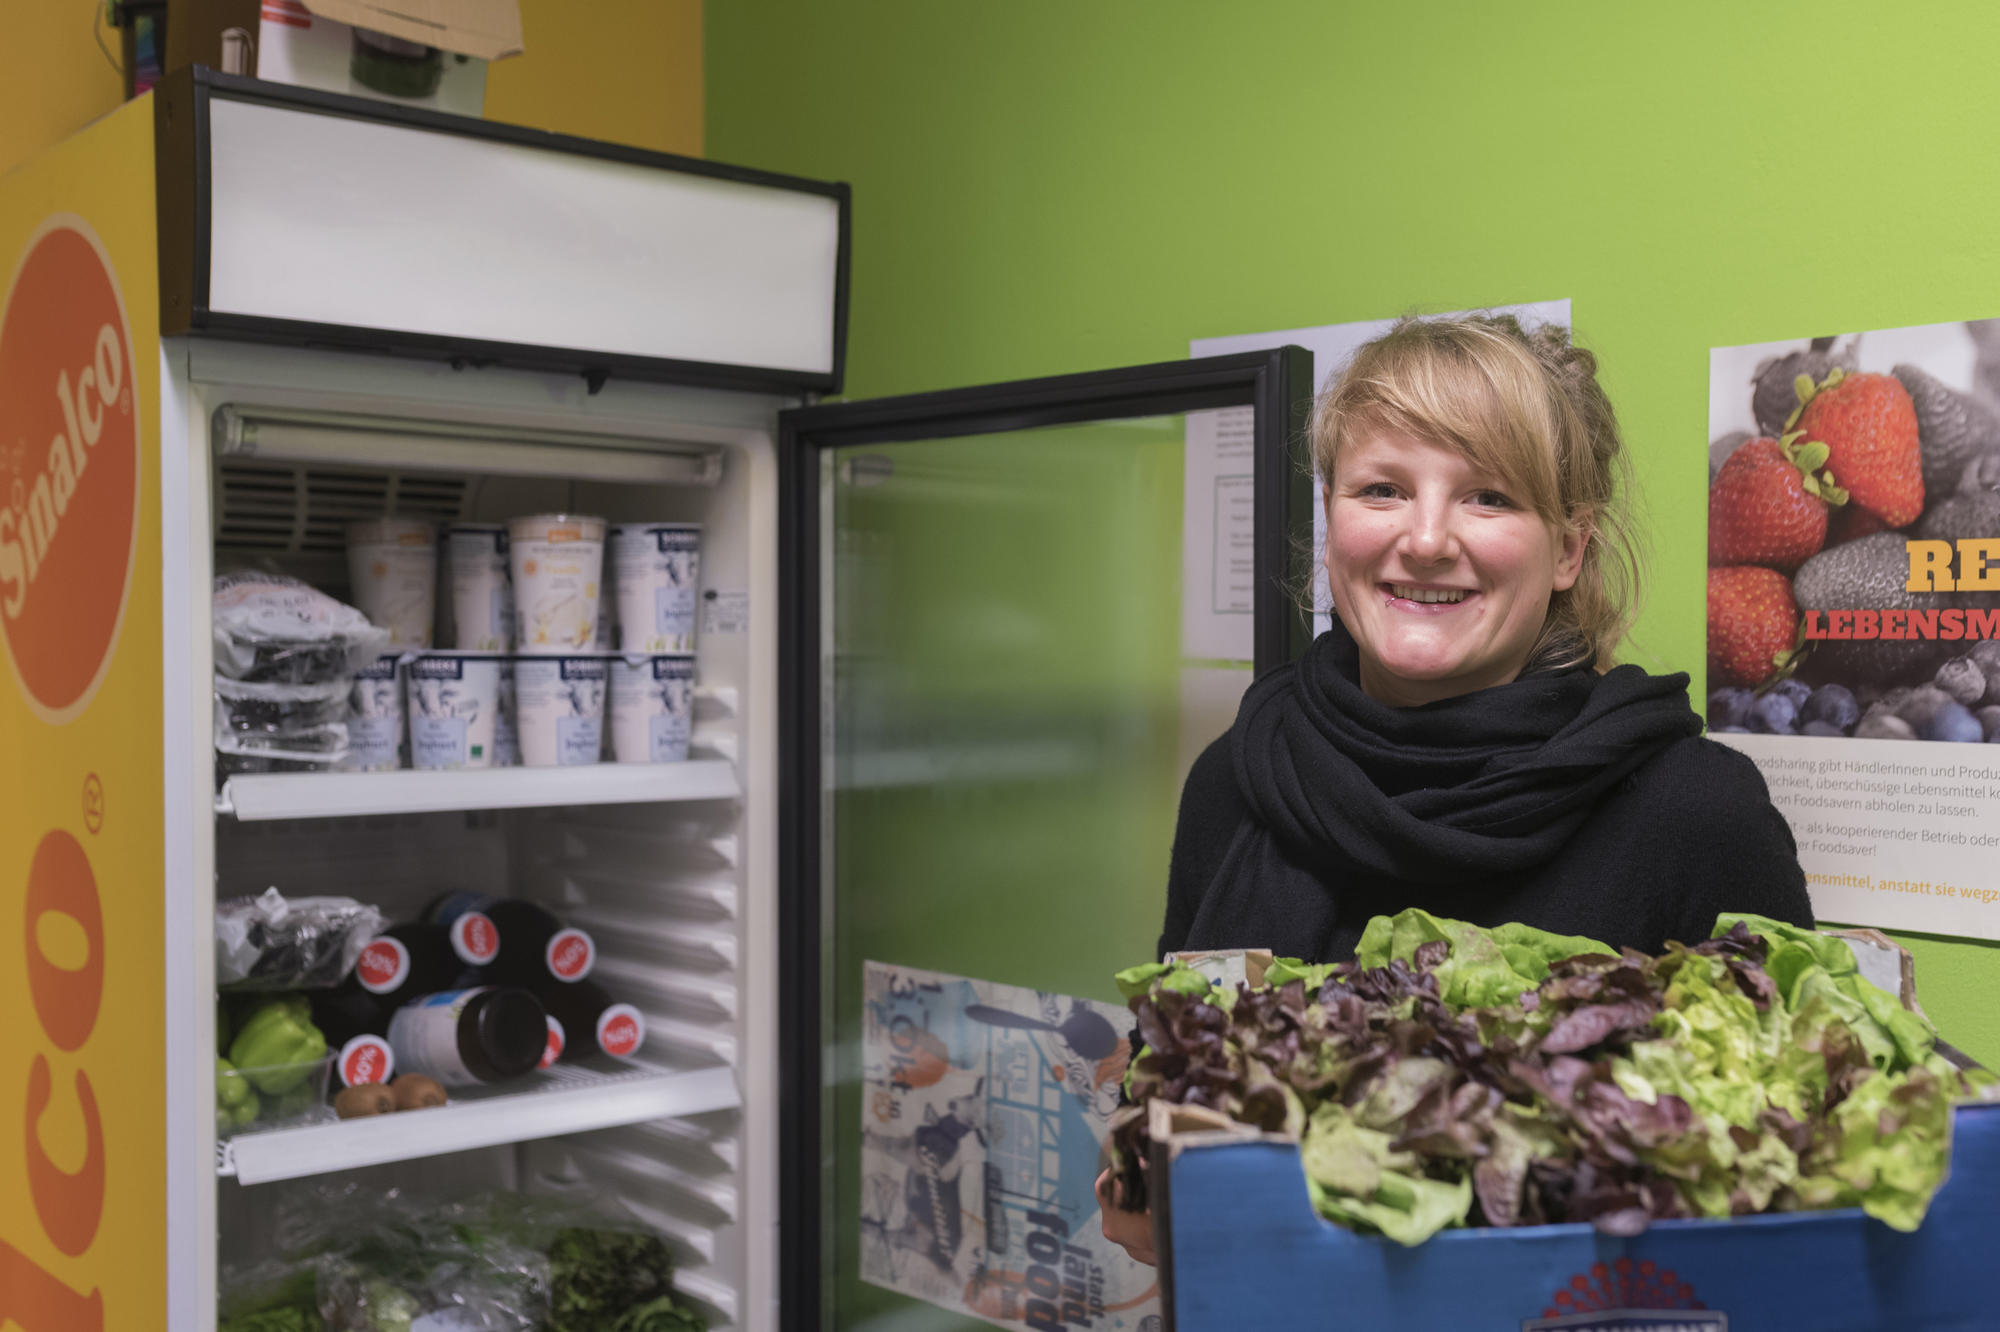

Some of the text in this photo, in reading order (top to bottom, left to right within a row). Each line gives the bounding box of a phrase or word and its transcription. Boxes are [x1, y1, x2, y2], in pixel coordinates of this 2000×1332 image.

[0, 323, 122, 620] Sinalco
[1906, 538, 2000, 592] RE
[1805, 609, 2000, 640] LEBENSM
[1755, 756, 1816, 774] oodsharing
[1819, 758, 1841, 774] gibt
[1844, 759, 1927, 776] HändlerInnen
[1931, 764, 1955, 778] und
[1816, 776, 1900, 796] überschüssige
[1903, 782, 1986, 798] Lebensmittel
[1794, 793, 1862, 809] Foodsavern
[1865, 799, 1915, 813] abholen
[1918, 803, 1932, 815] zu
[1935, 802, 1979, 818] lassen.
[1807, 821, 1823, 834] als
[1826, 821, 1919, 841] kooperierender
[1921, 827, 1967, 845] Betrieb
[1970, 832, 1999, 847] oder
[1812, 839, 1877, 856] Foodsaver!
[1806, 872, 1875, 891] ensmittel,
[1879, 878, 1931, 895] anstatt
[1935, 881, 1956, 897] sie
[1025, 1209, 1069, 1332] food
[1063, 1243, 1093, 1328] land
[1088, 1263, 1106, 1319] stadt
